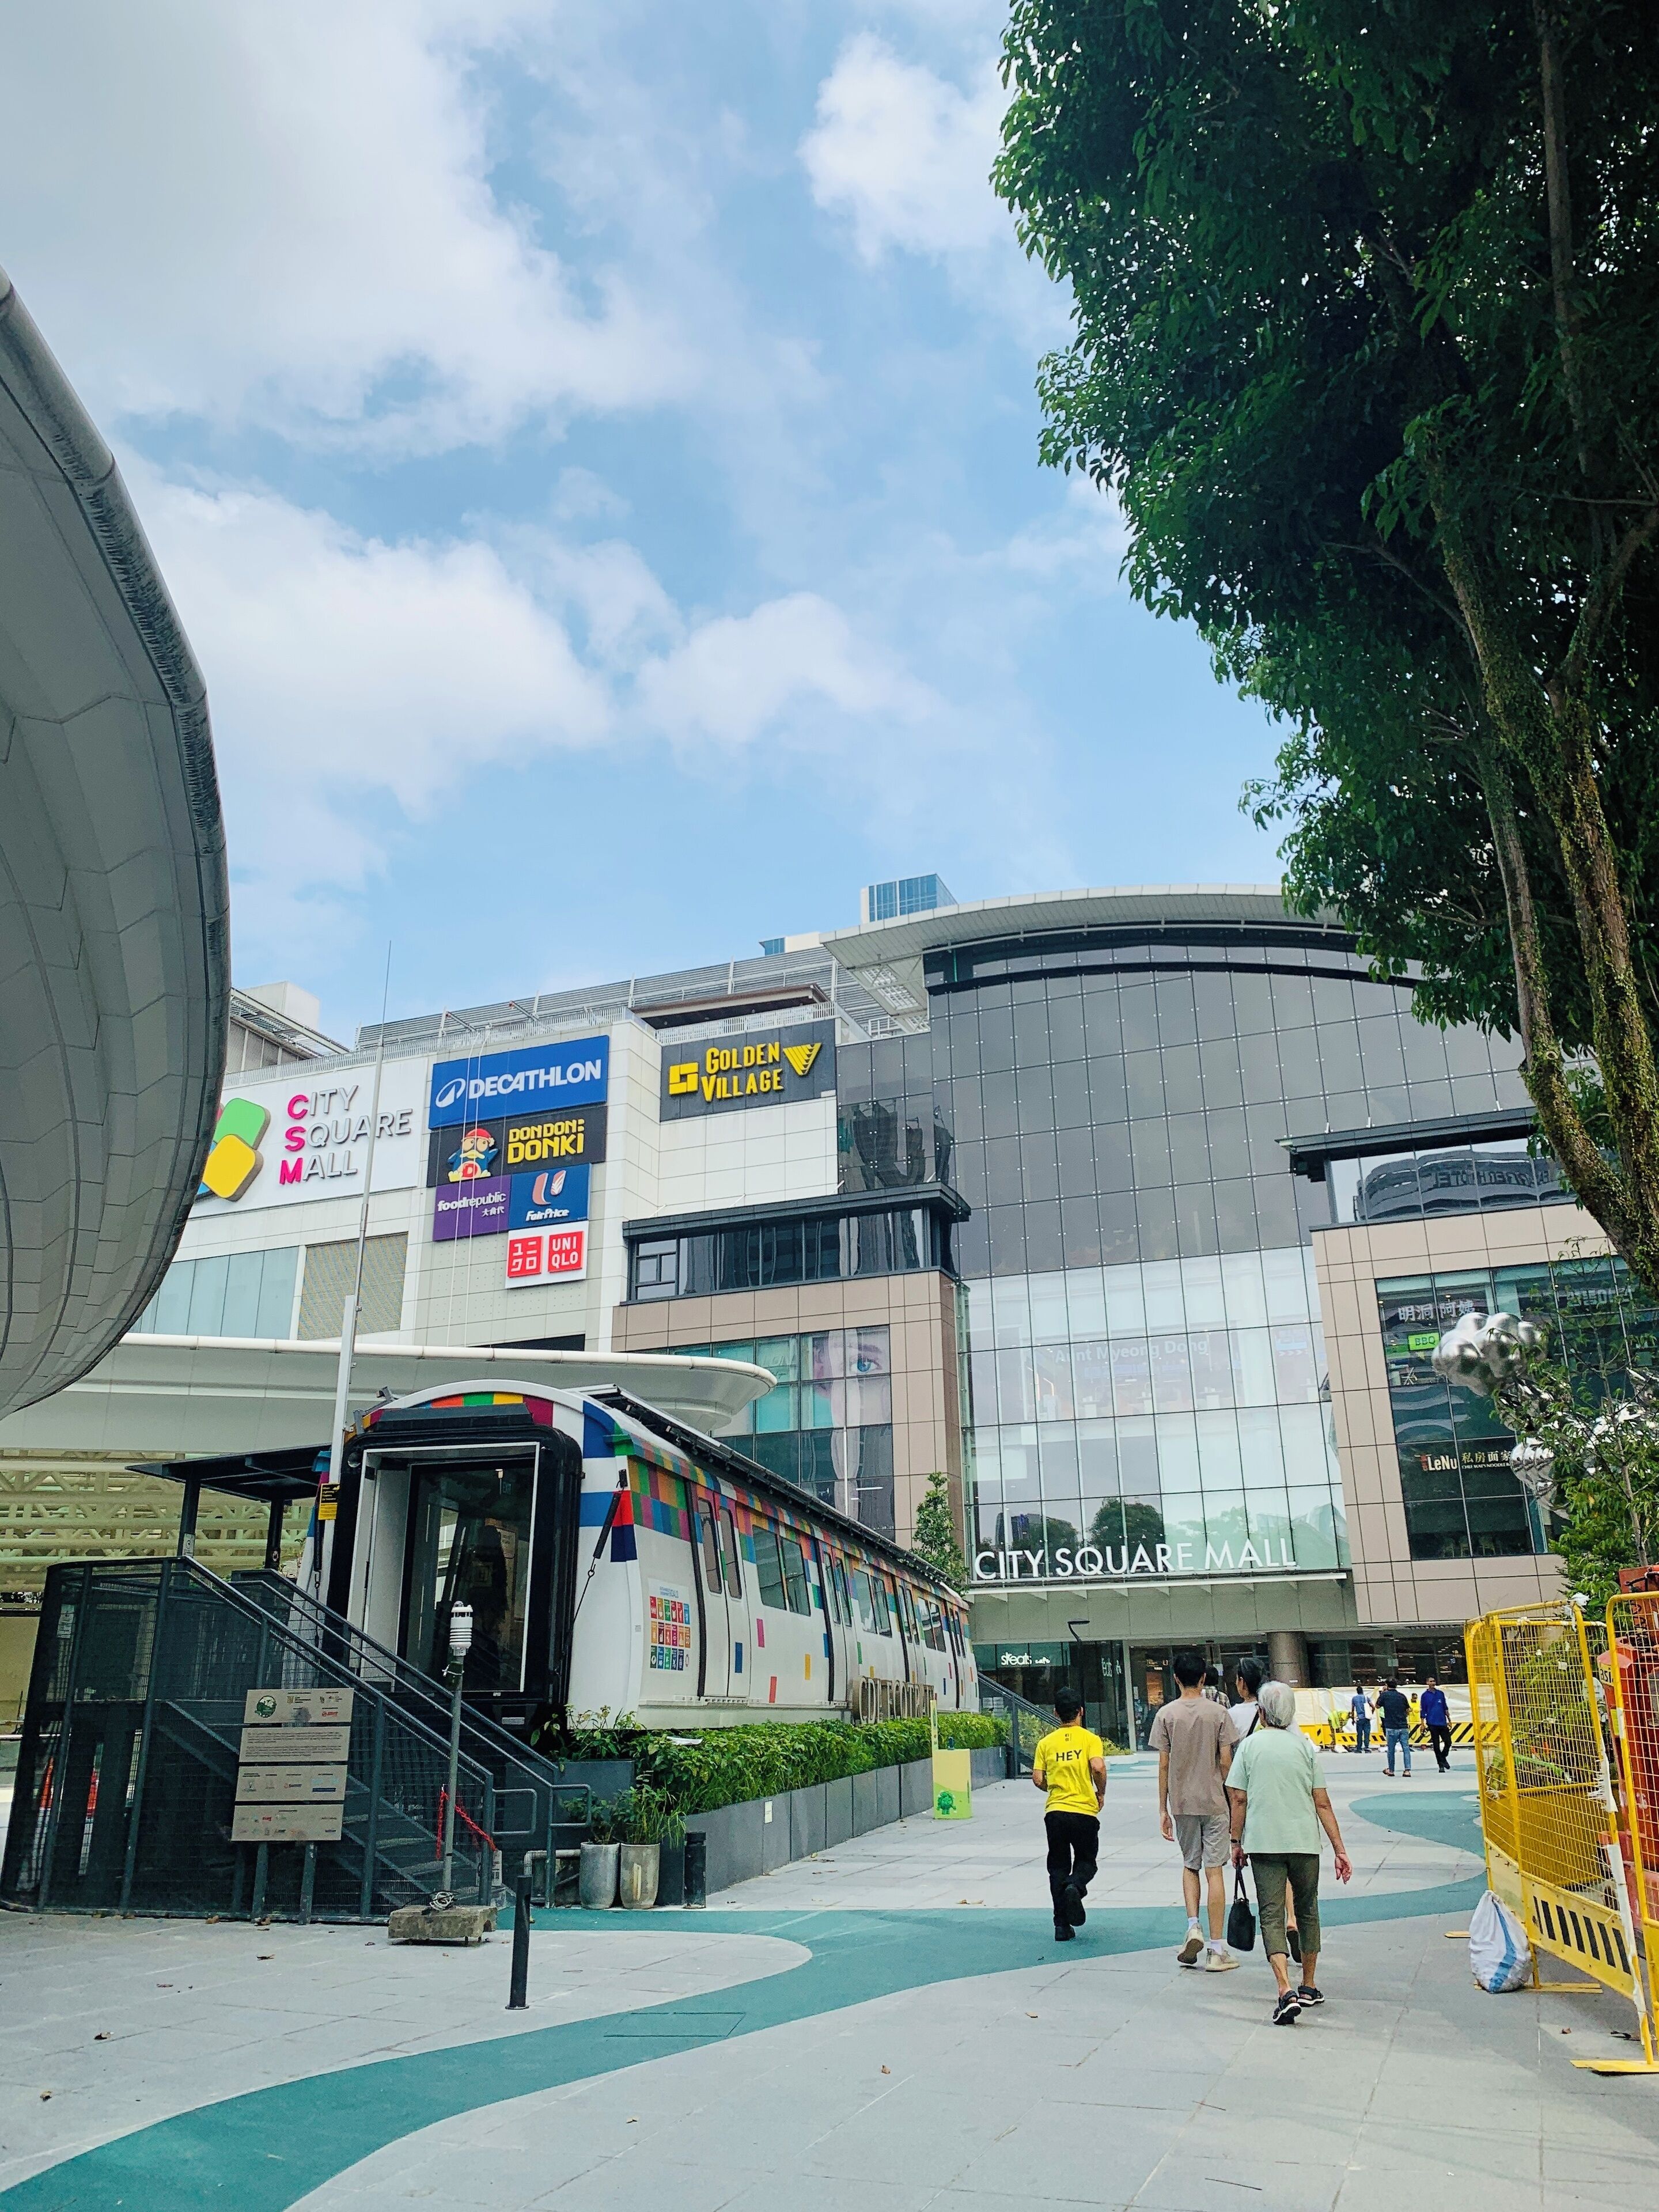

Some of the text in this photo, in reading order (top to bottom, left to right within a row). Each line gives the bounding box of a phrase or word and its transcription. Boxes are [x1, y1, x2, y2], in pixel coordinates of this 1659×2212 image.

[706, 1041, 780, 1074] GOLDEN
[468, 1059, 601, 1099] DECATHLON
[700, 1069, 784, 1102] VILLAGE
[287, 1085, 359, 1120] CITY
[285, 1108, 413, 1152] SQUARE
[507, 1132, 584, 1164] DONKI
[279, 1150, 358, 1185] MALL
[482, 1206, 505, 1217] 大食代
[525, 1208, 569, 1221] FairPrice
[552, 1236, 577, 1252] UNI
[551, 1251, 578, 1269] QLO
[1055, 1339, 1209, 1363] Aunt Myeong Dong
[1415, 1336, 1435, 1346] BBQ
[1427, 1455, 1458, 1471] LeNu
[974, 1538, 1297, 1580] CITY SQUARE MALL
[1056, 1749, 1082, 1762] HEY
